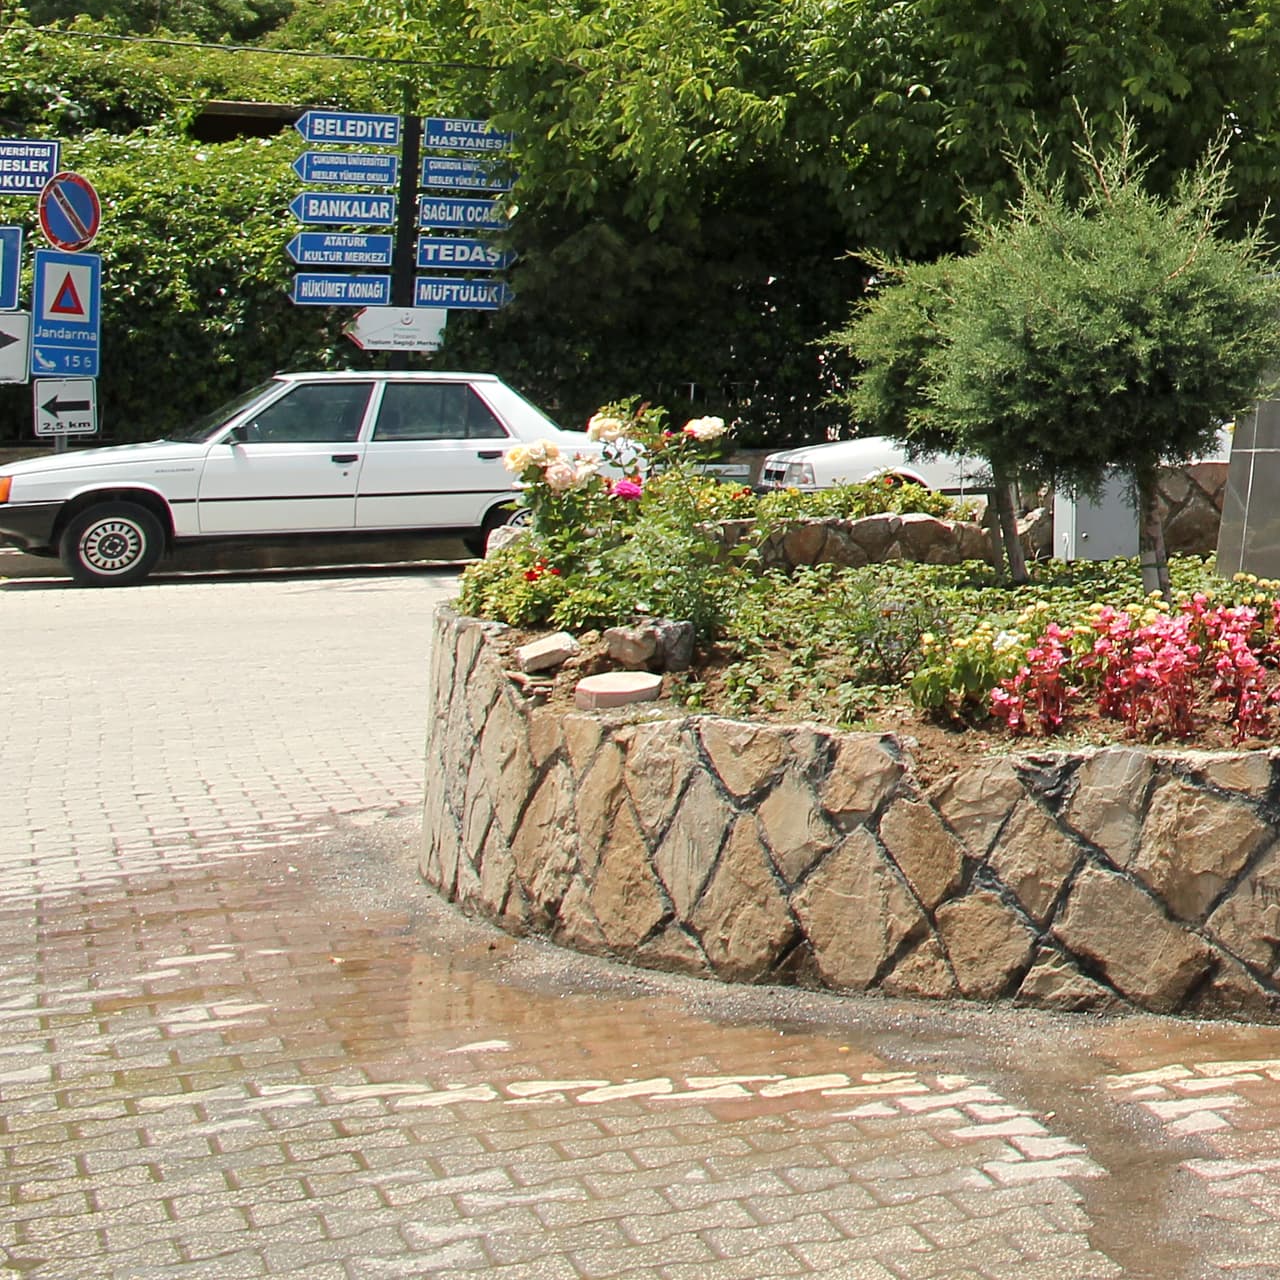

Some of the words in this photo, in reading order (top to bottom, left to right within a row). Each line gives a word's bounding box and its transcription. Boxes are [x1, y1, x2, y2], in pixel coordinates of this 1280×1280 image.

[445, 122, 496, 134] DEVLE
[0, 175, 46, 187] KULU
[308, 199, 390, 218] BANKALAR
[423, 202, 464, 221] SAĞLIK
[423, 244, 501, 266] TEDAŞ
[420, 284, 498, 303] MÜFTÜLÜK
[35, 326, 97, 341] Jandarma
